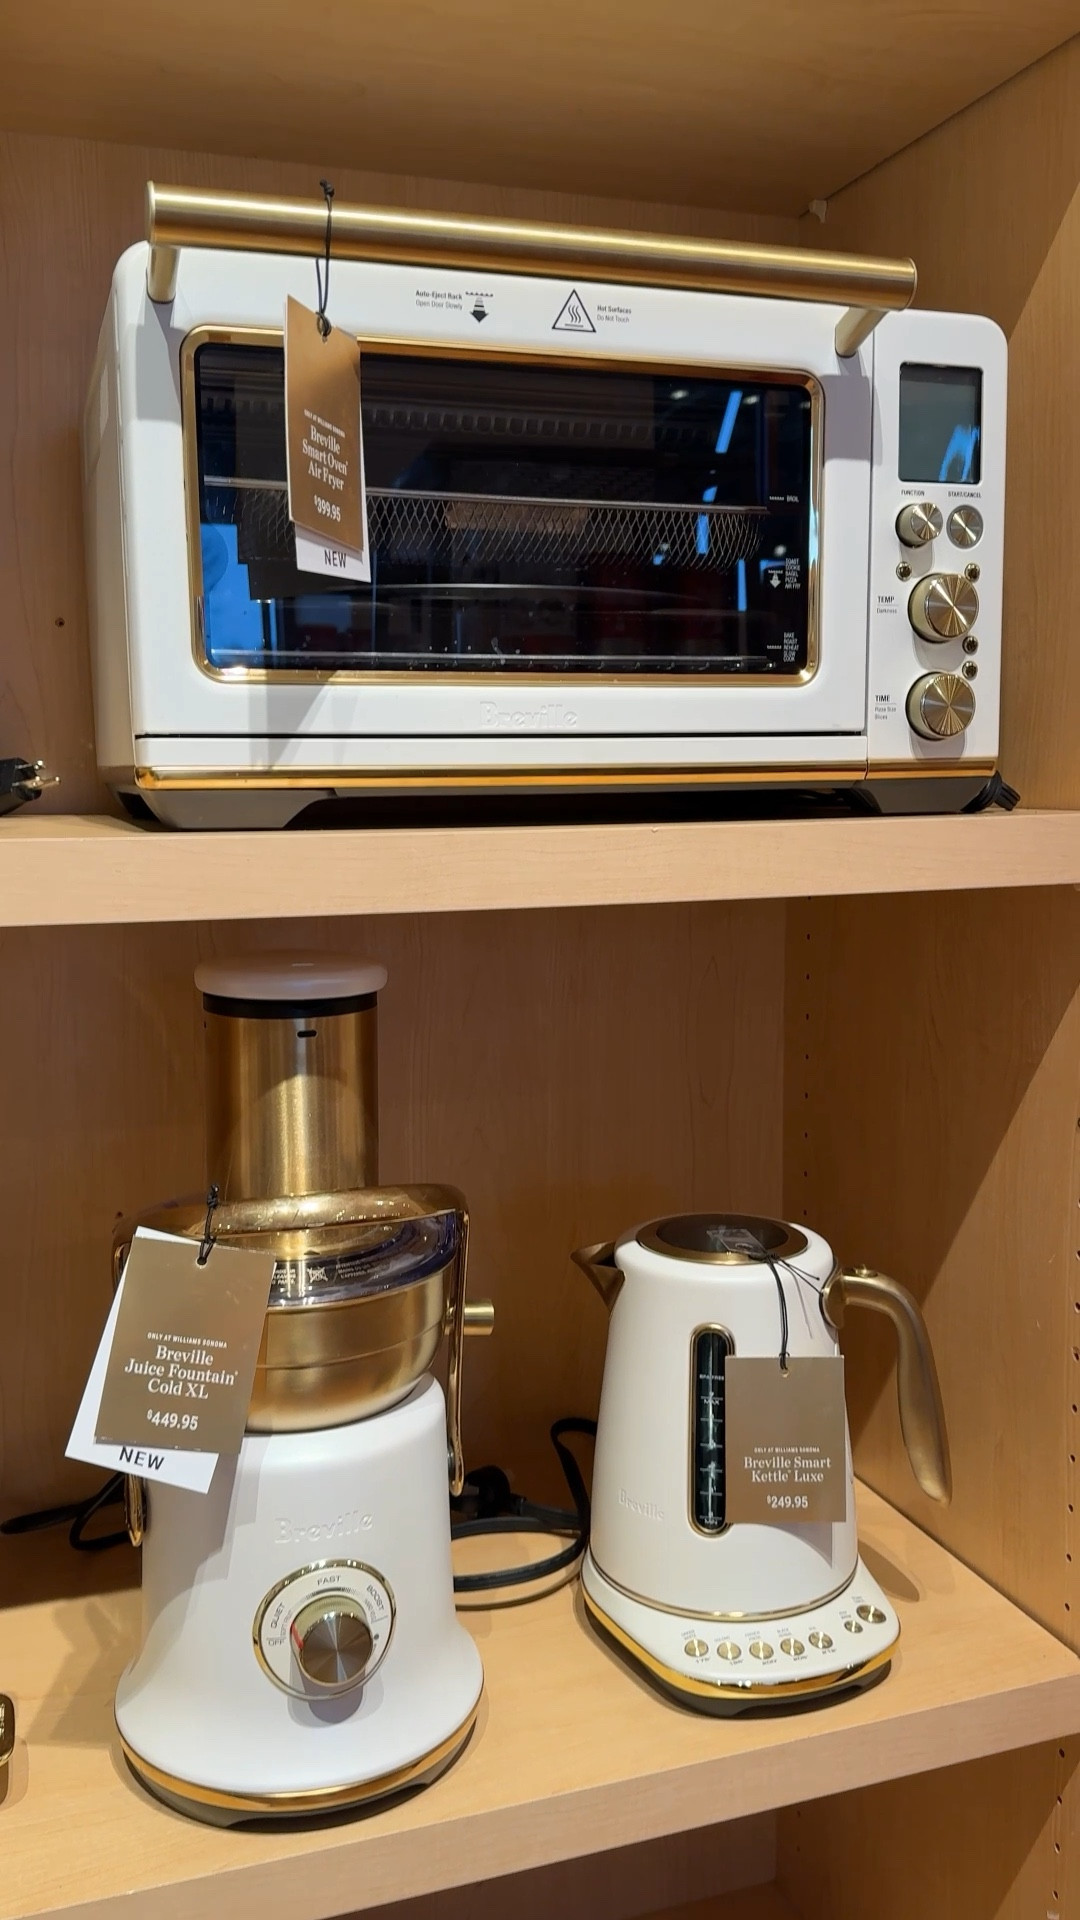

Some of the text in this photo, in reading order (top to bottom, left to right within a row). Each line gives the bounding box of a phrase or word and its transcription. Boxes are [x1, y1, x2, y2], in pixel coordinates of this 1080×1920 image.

[310, 424, 340, 455] Breville
[302, 438, 327, 465] Smart
[308, 460, 344, 491] Air Fryer
[900, 489, 925, 497] FUNCTION
[948, 490, 982, 498] START/CANCEL
[314, 494, 341, 522] $399.95
[324, 549, 346, 569] NEW
[877, 596, 894, 604] TEMP
[875, 694, 890, 702] TIME
[479, 700, 578, 728] Breville
[147, 1332, 162, 1340] ONLY
[172, 1334, 201, 1346] WILLIAMS
[202, 1338, 228, 1348] SONOMA
[156, 1344, 214, 1366] Breville
[124, 1357, 165, 1378] Juice
[148, 1378, 209, 1400] Cold XL
[146, 1408, 199, 1431] $449.95
[119, 1446, 165, 1470] NEW
[744, 1456, 832, 1469] Breville Smart
[794, 1470, 824, 1482] Luxe
[619, 1488, 664, 1521] Breville
[766, 1494, 808, 1508] $249.95
[274, 1510, 374, 1544] Breville
[317, 1575, 342, 1586] FAST
[366, 1584, 384, 1610] BOOST
[270, 1602, 285, 1628] QUIET
